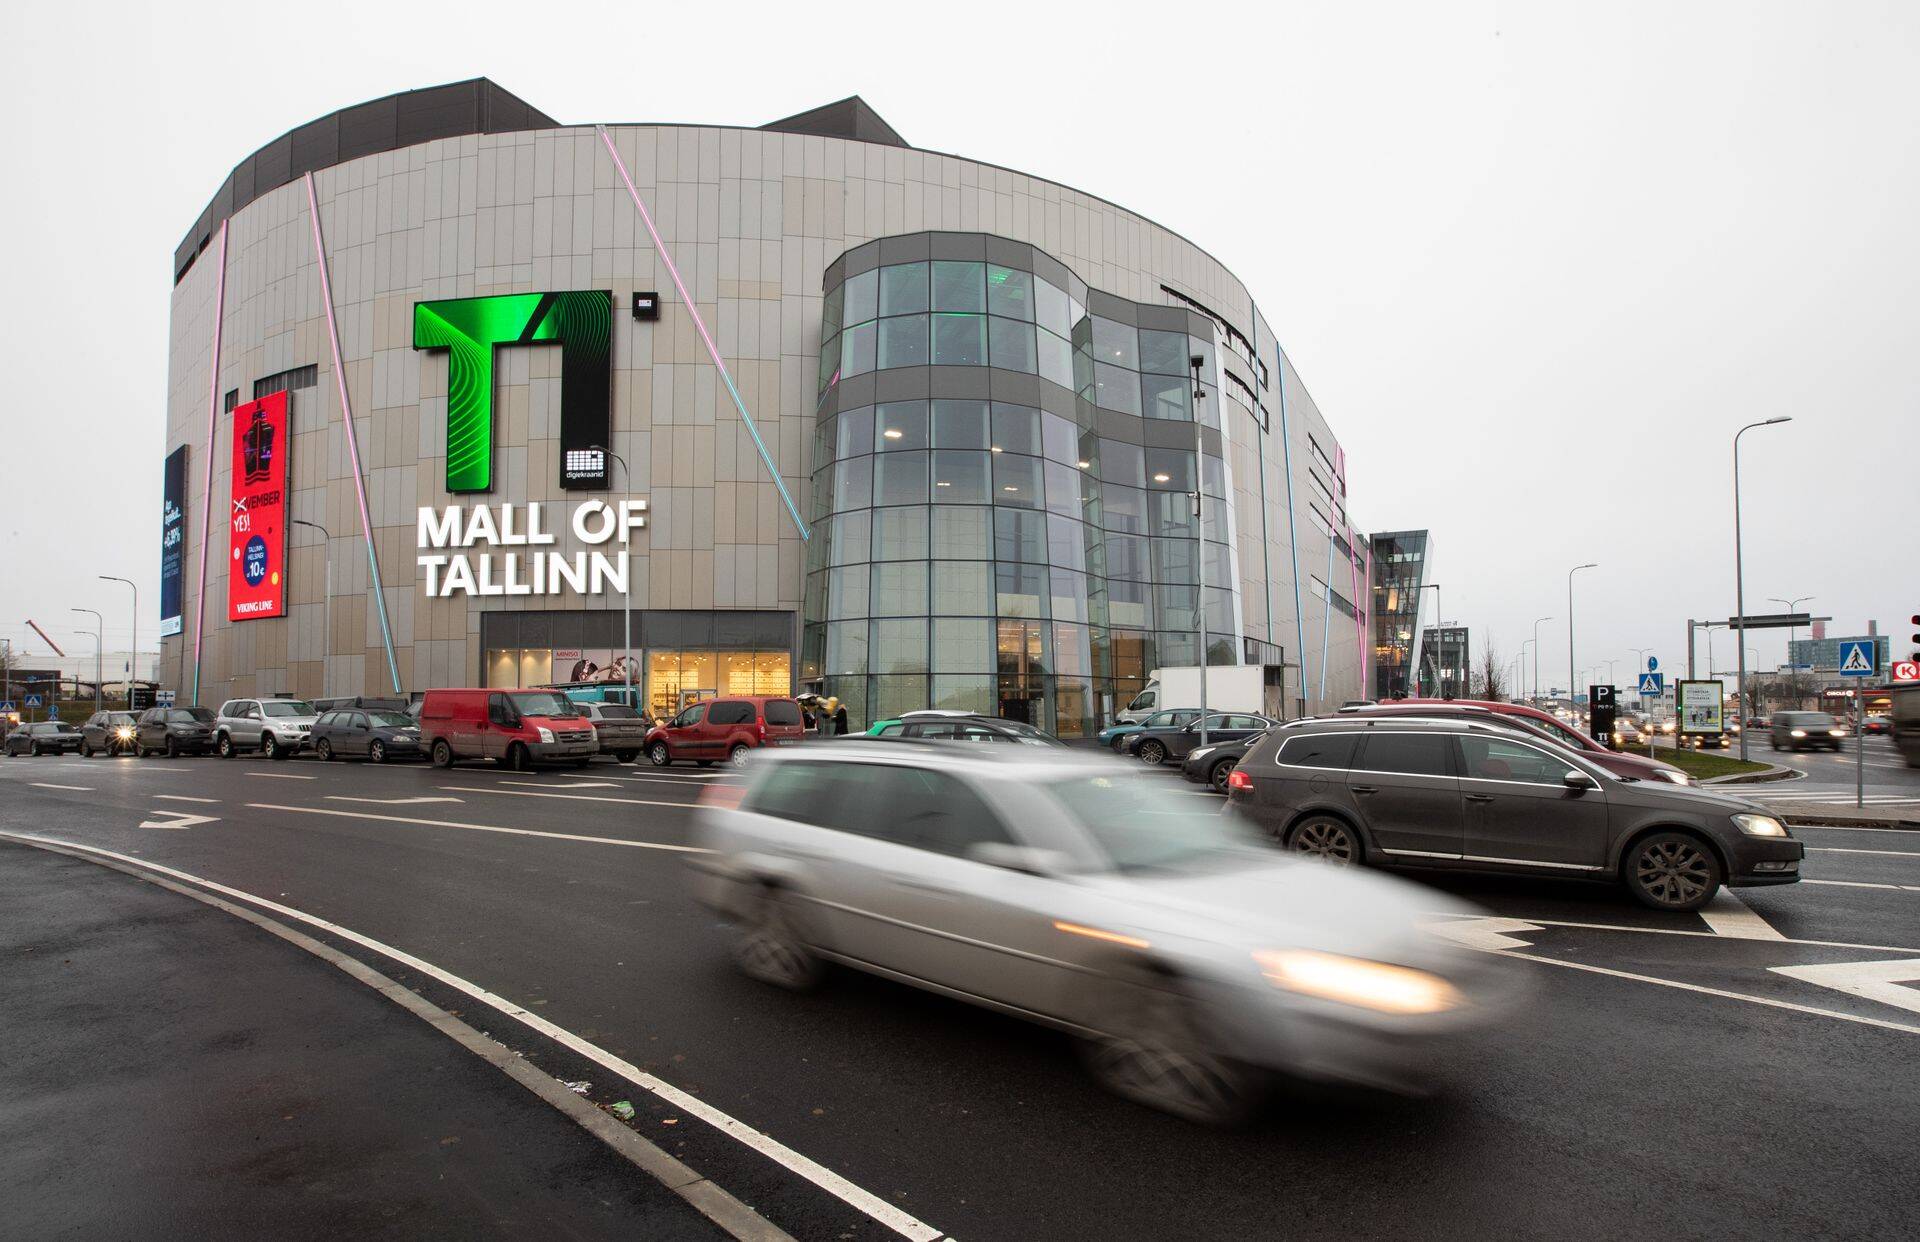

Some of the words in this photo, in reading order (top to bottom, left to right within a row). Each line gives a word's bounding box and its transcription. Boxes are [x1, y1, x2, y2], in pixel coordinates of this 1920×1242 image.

[566, 470, 604, 479] digiekraanid
[234, 513, 250, 533] YES!
[417, 501, 554, 548] MALL
[572, 499, 648, 544] OF
[417, 551, 629, 596] TALLINN
[237, 602, 258, 613] VIKING
[259, 600, 273, 611] LINE
[1598, 687, 1609, 701] P
